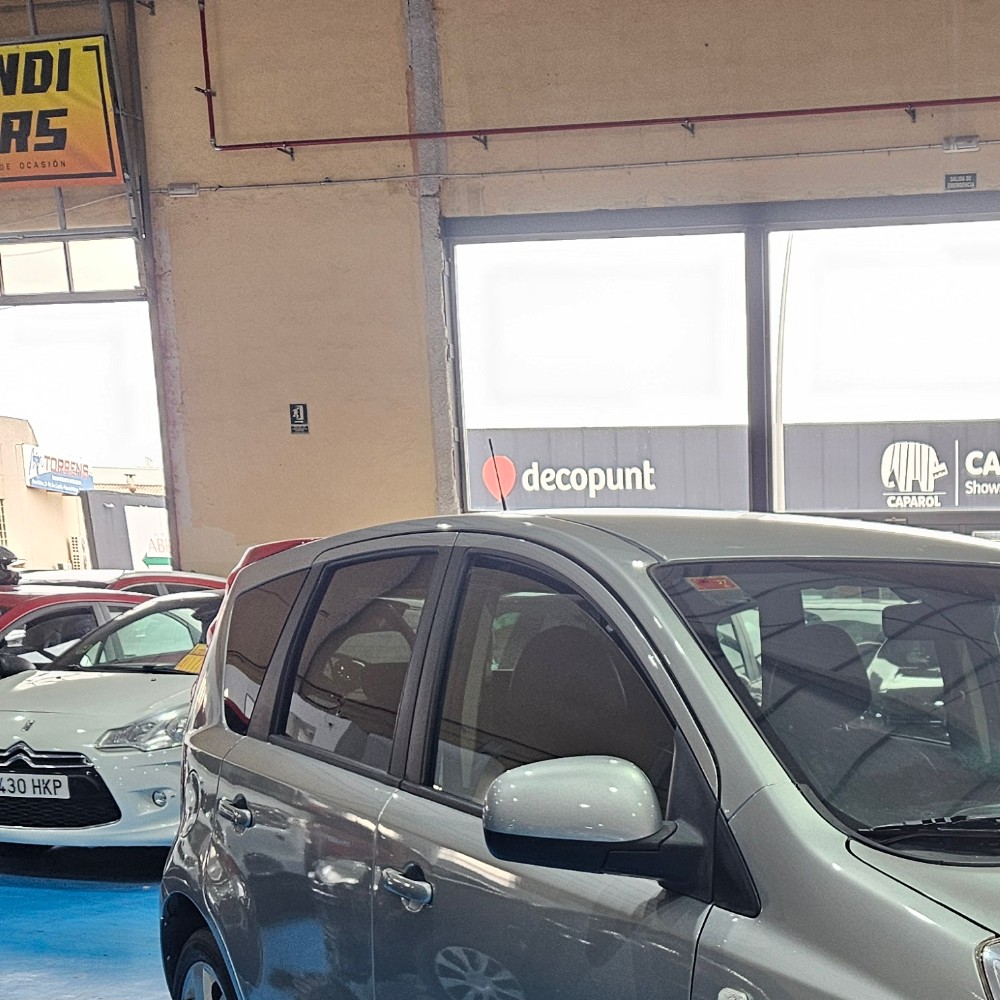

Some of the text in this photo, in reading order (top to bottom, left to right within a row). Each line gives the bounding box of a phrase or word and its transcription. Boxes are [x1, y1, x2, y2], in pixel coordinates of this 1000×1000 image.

[19, 159, 66, 169] OCASIÓN
[521, 459, 657, 499] decopunt
[886, 495, 942, 508] CAPAROL
[31, 778, 62, 796] HKP
